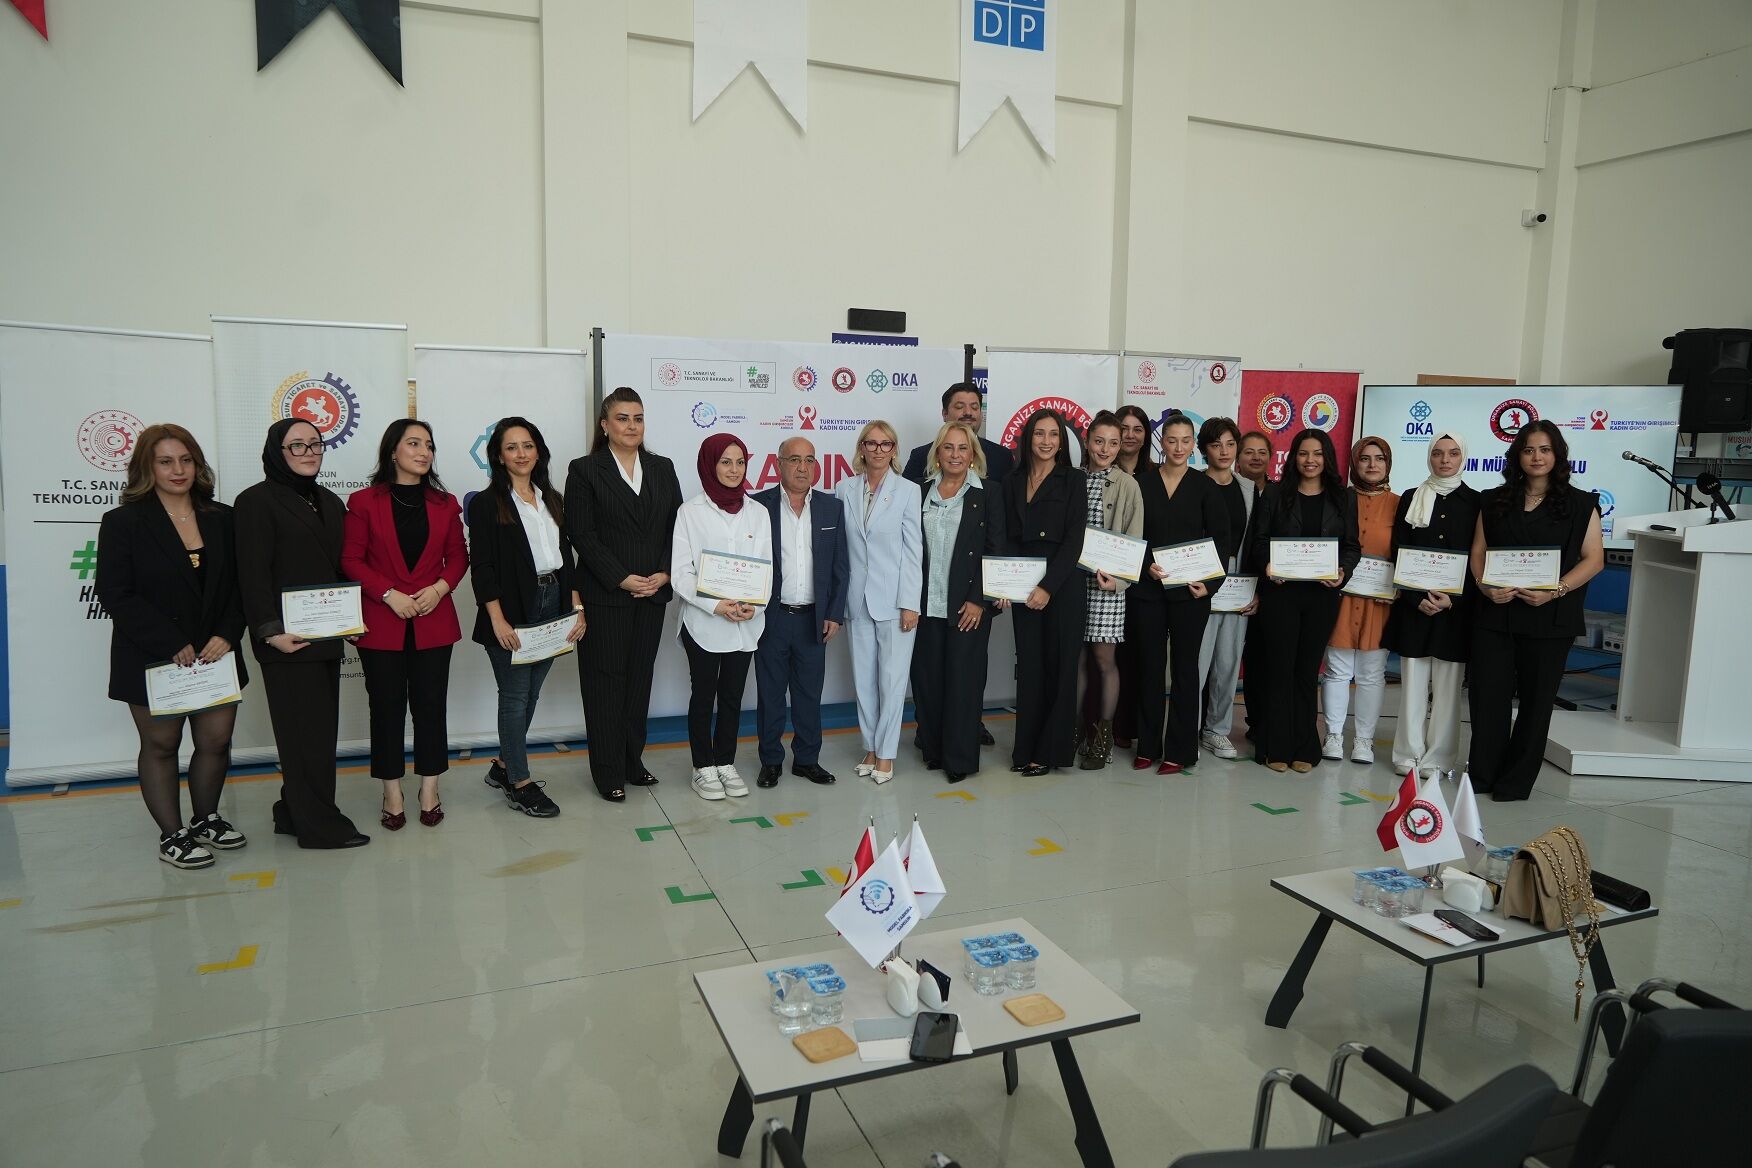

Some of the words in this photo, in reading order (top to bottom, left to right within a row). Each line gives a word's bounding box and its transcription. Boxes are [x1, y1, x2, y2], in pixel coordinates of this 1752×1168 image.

[892, 372, 918, 386] OKA
[1406, 422, 1434, 436] OKA
[62, 480, 86, 490] T.C.
[33, 494, 114, 504] TEKNOLOJİ
